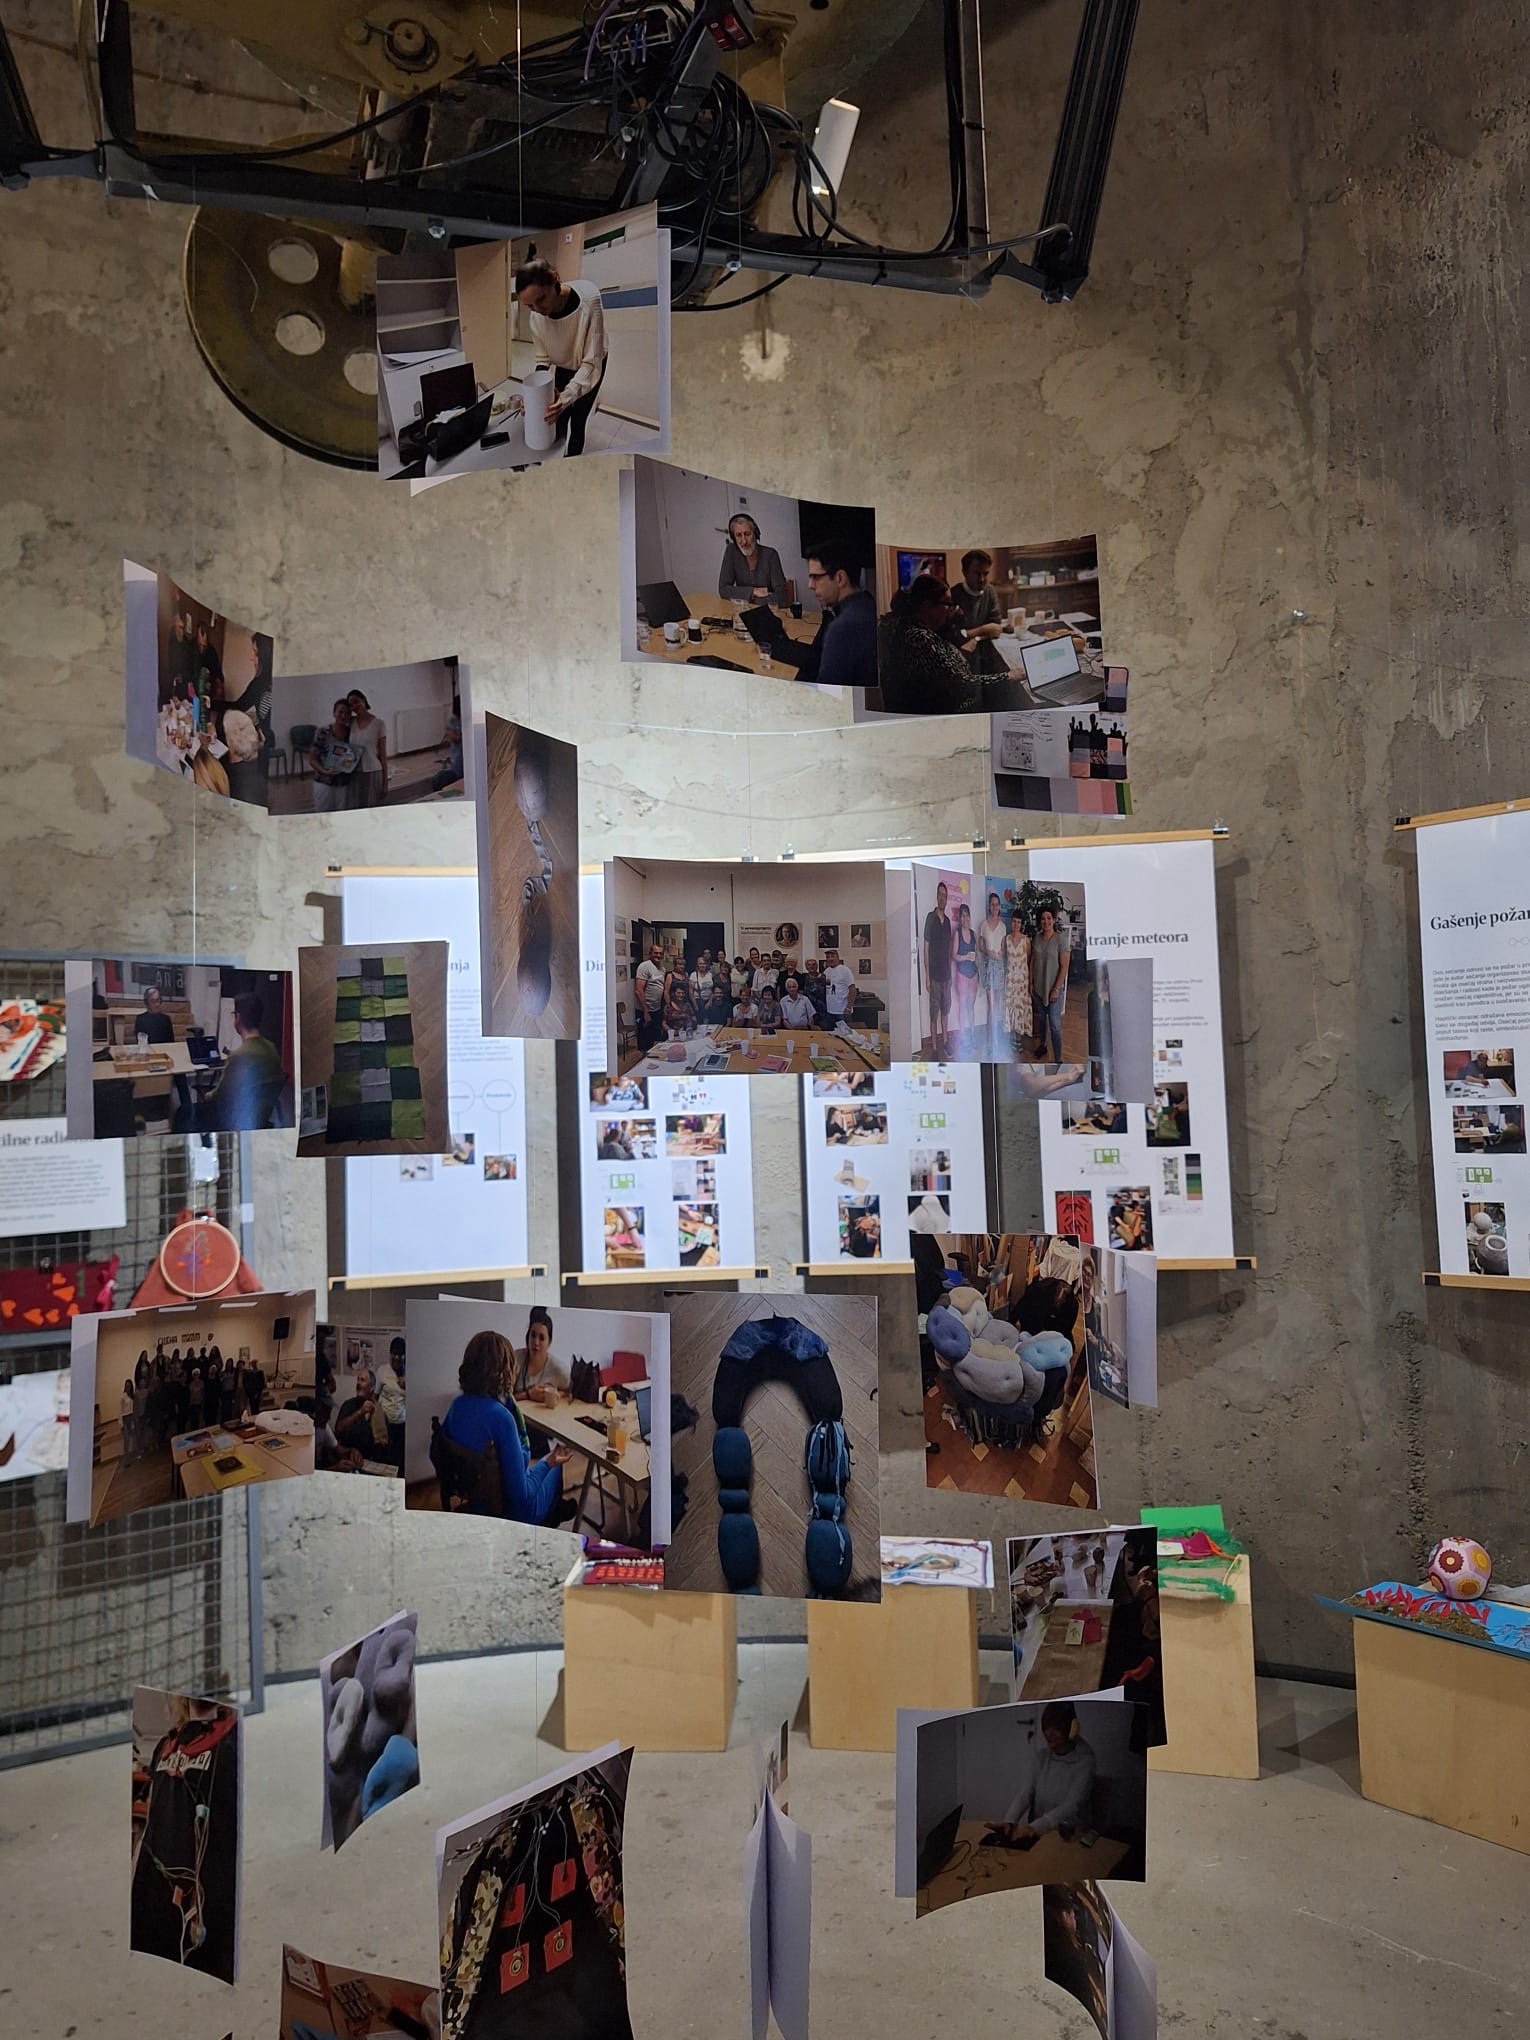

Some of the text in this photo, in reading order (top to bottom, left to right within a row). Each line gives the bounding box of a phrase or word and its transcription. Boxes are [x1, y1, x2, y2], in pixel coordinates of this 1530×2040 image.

[1430, 911, 1488, 930] Gašenje
[1086, 932, 1189, 948] tranje meteora
[450, 959, 470, 974] nja
